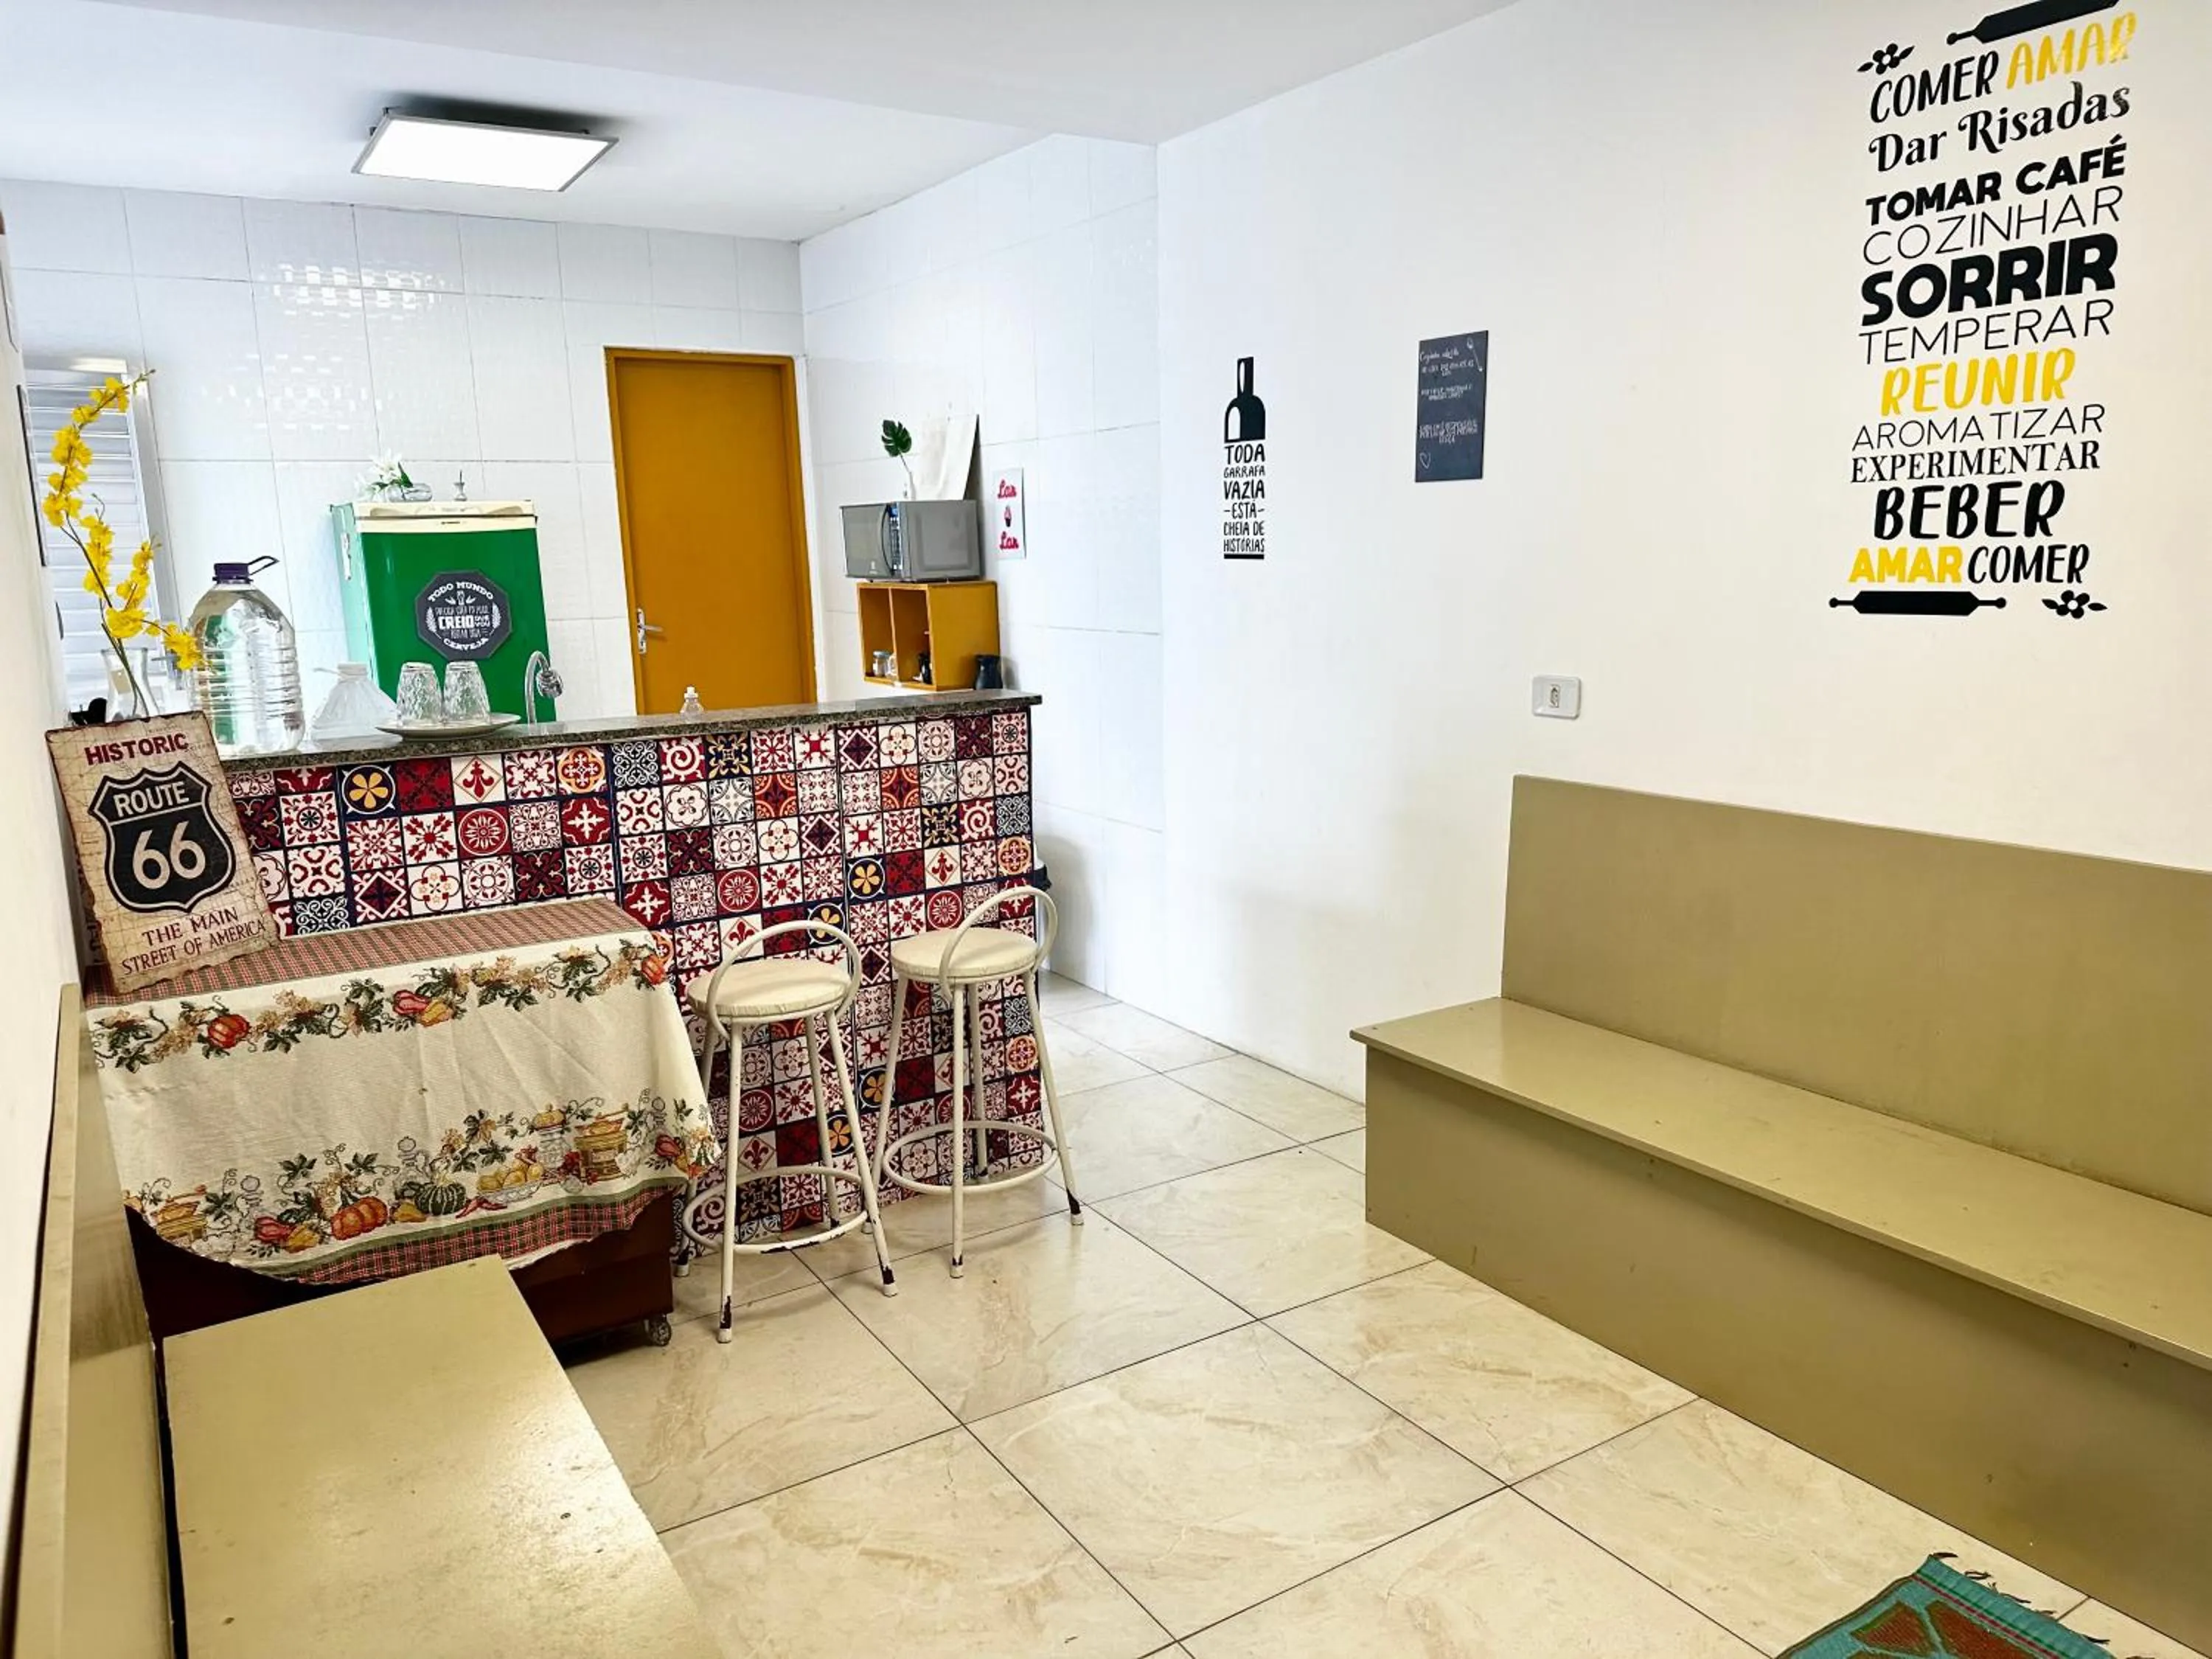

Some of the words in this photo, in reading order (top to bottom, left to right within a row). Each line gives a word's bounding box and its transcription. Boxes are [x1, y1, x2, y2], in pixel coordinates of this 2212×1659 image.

[1870, 50, 2000, 124] COMER
[2005, 10, 2138, 90] AMAR
[1868, 131, 1947, 173] Dar
[1958, 80, 2131, 154] Risadas
[1865, 171, 2002, 226] TOMAR
[2015, 133, 2127, 195] CAFÉ
[1863, 185, 2124, 266] COZINHAR
[1861, 232, 2118, 327] SORRIR
[1858, 298, 2114, 365] TEMPERAR
[1879, 347, 2077, 418] REUNIR
[1851, 403, 2106, 451] AROMATIZAR
[1224, 443, 1266, 465] TODA
[1224, 465, 1266, 479] GARRAFA
[1850, 440, 2101, 484] EXPERIMENTAR
[1224, 479, 1265, 501] VAZIA
[1873, 479, 2065, 540] BEBER
[1223, 521, 1250, 536] CHEIA
[1253, 521, 1265, 536] DE
[1847, 544, 1965, 585] AMAR
[1967, 543, 2090, 584] COMER
[428, 583, 453, 602] TODO
[456, 582, 493, 599] MUNDO
[437, 614, 476, 630] CREIO
[84, 733, 189, 765] HISTORIC
[113, 781, 190, 817] ROUTE
[132, 821, 206, 890] 66
[121, 947, 178, 975] STREET
[184, 936, 204, 956] OF
[209, 917, 267, 947] AMERICA
[142, 922, 184, 947] THE
[189, 906, 240, 933] MAIN
